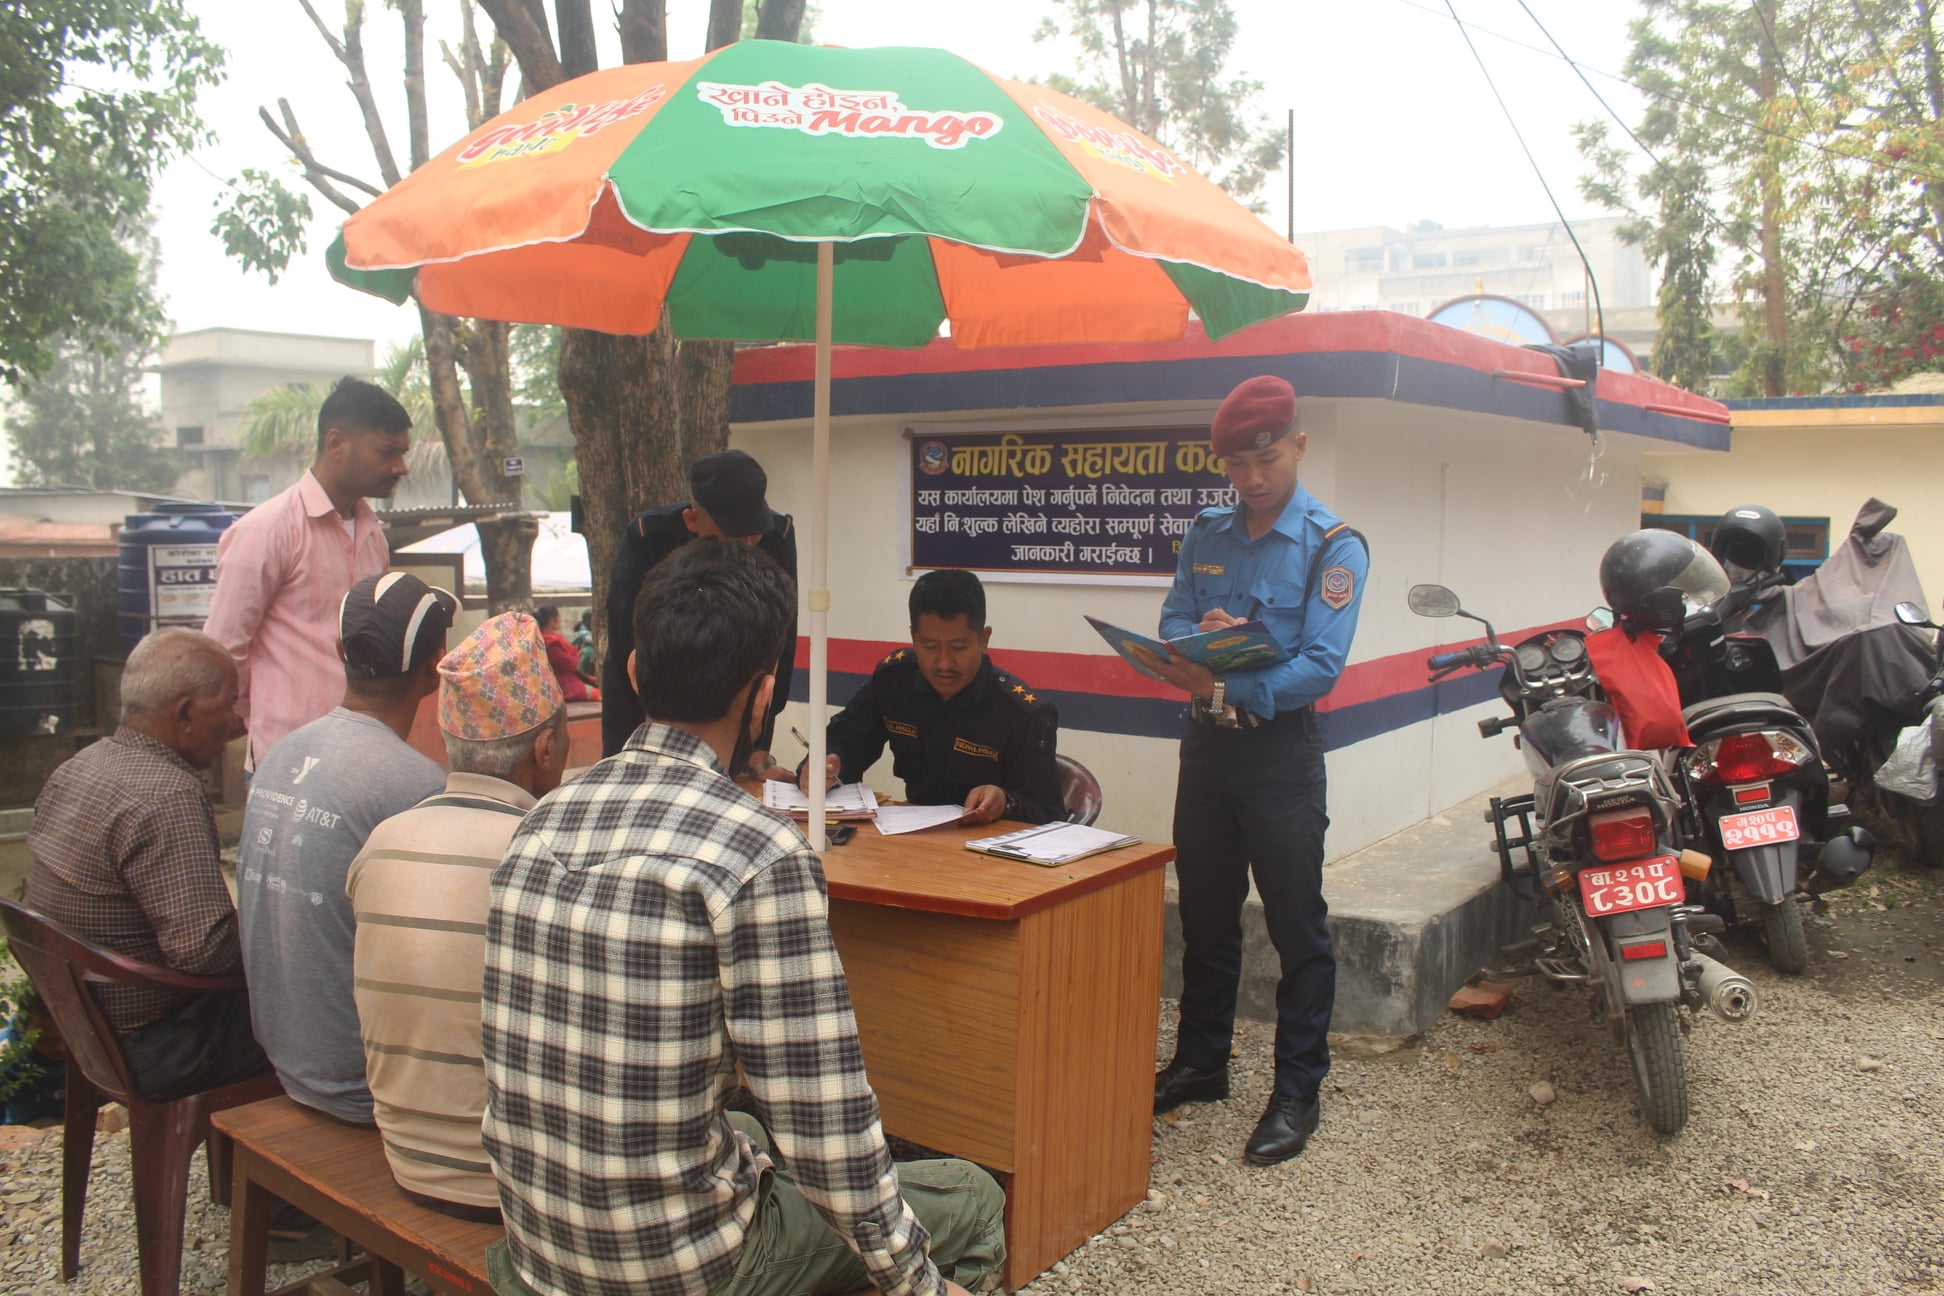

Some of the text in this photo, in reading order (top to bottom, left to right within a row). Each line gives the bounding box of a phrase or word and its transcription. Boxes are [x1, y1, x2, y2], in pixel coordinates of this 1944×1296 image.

[708, 86, 898, 112] खाने होइन,
[731, 107, 995, 146] पिउने Mango
[951, 433, 1054, 478] नागरिक
[1061, 441, 1168, 478] सहायता
[918, 490, 941, 506] यस
[944, 486, 1018, 506] कार्यालयमा
[1022, 485, 1046, 506] पेश
[1050, 484, 1097, 510] गर्नुपर्ने
[1102, 483, 1155, 506] निवेदन
[1160, 488, 1192, 506] तथा
[1002, 512, 1048, 533] लेखिने
[1052, 513, 1100, 535] व्यहोरा
[1105, 514, 1155, 539] सम्पूर्ण
[1011, 541, 1075, 562] जानकारी
[1079, 542, 1142, 565] गराईन्छ
[1596, 797, 1637, 809] HONDA
[1739, 803, 1770, 812] HONDA
[305, 807, 341, 830] AT&T
[1590, 876, 1678, 911] ८३०८
